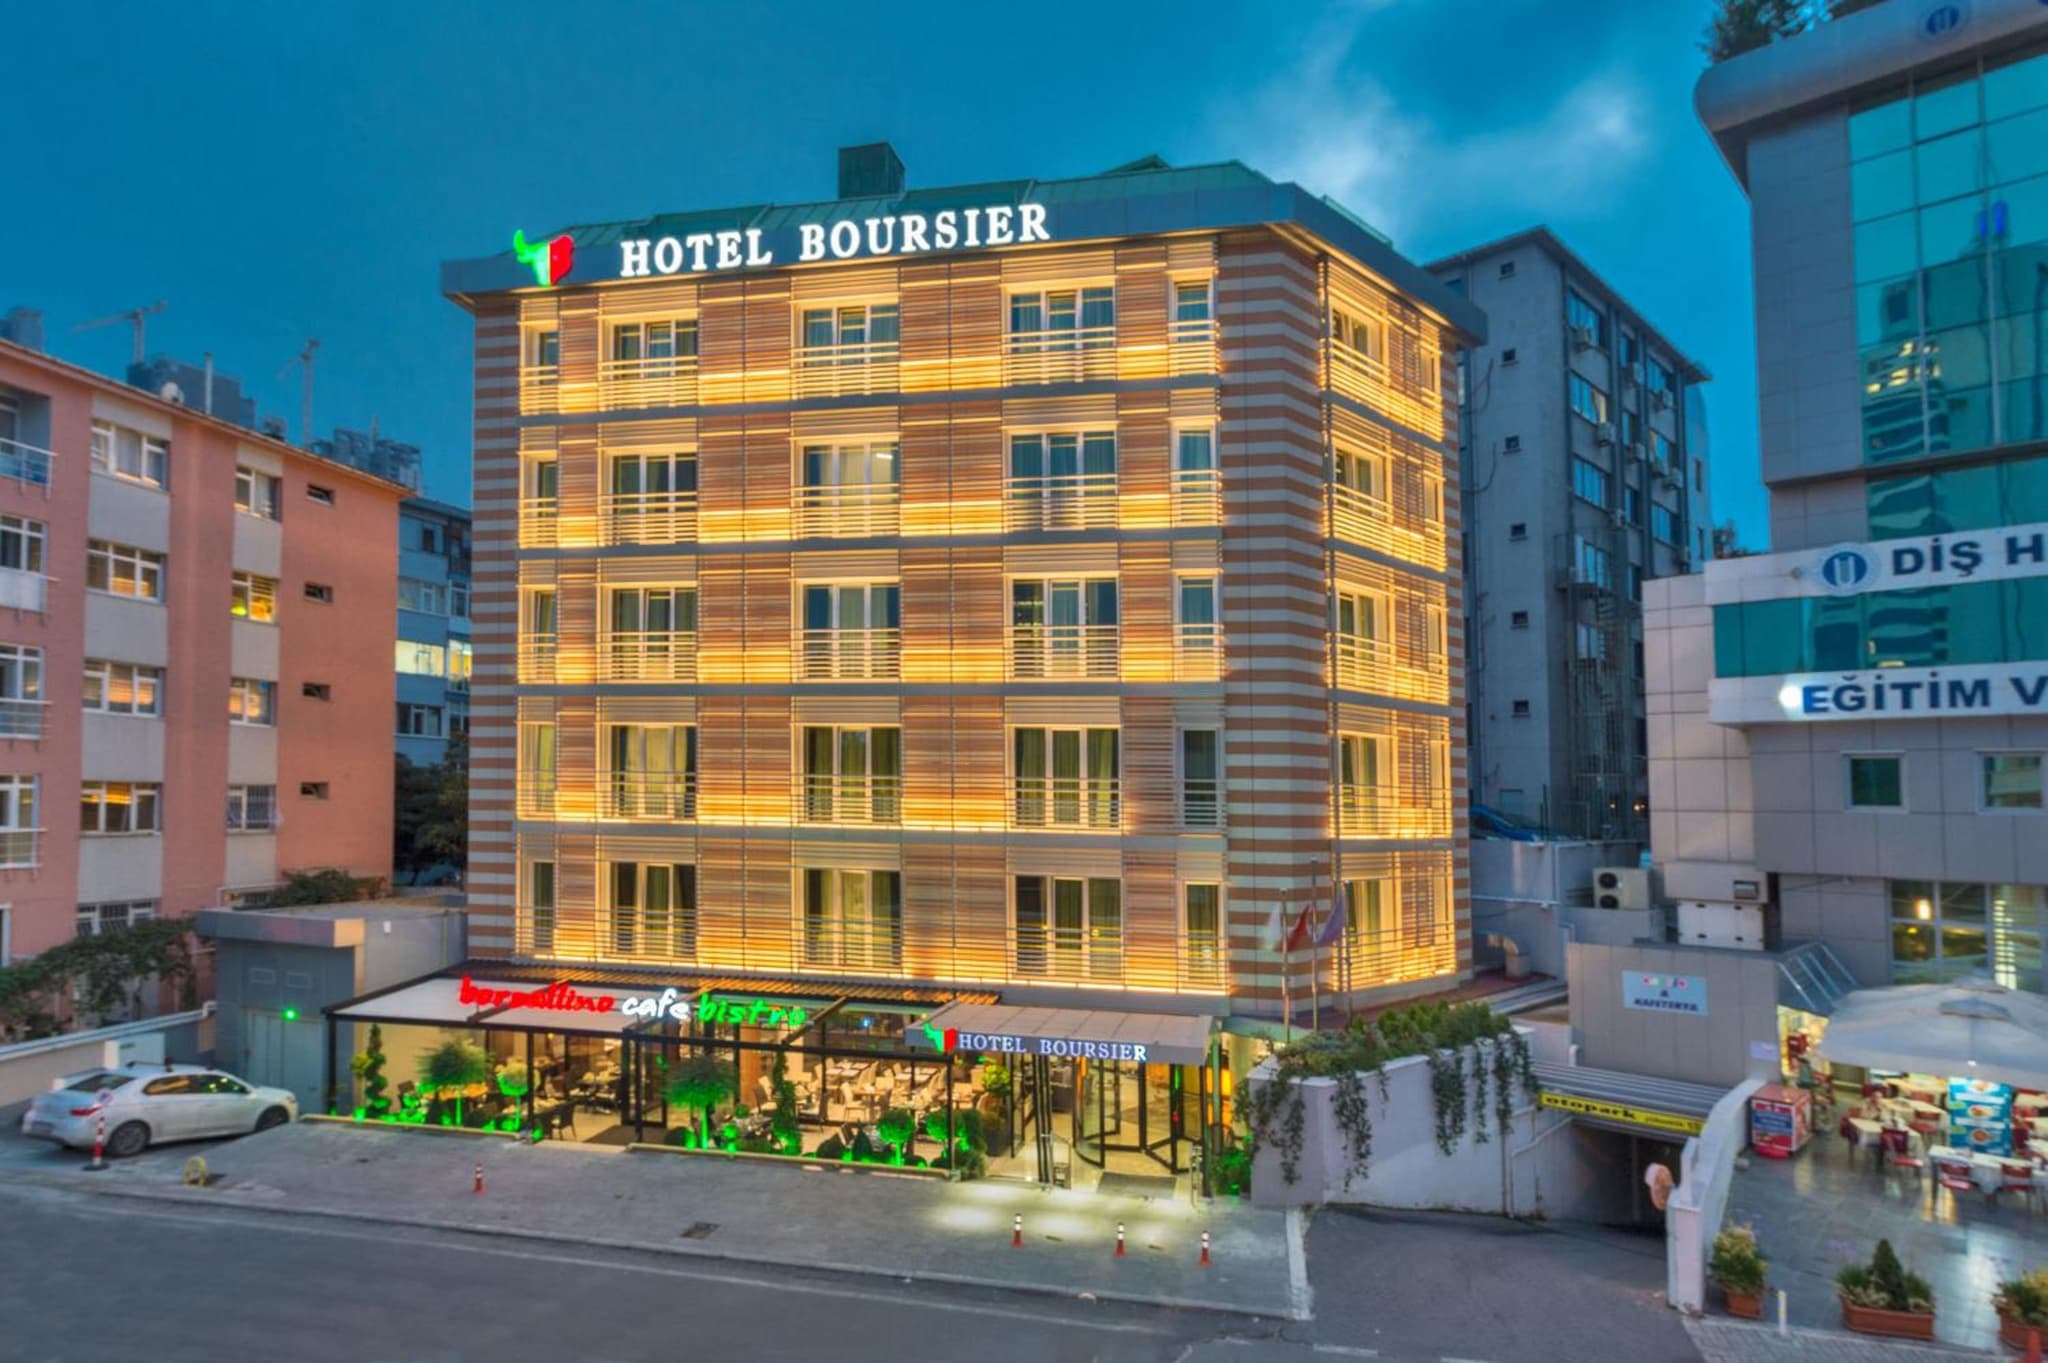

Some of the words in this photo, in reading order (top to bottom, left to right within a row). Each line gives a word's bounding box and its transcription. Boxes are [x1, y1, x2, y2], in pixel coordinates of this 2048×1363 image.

[619, 229, 773, 278] HOTEL
[799, 203, 1050, 261] BOURSIER
[1892, 537, 1982, 577] DİŞ
[1802, 672, 1990, 714] EĞİTİM
[622, 988, 690, 1019] cafe
[698, 992, 807, 1027] bistro
[958, 1033, 1026, 1053] HOTEL
[1040, 1039, 1148, 1061] BOURSIER
[1546, 1097, 1635, 1120] otopark
